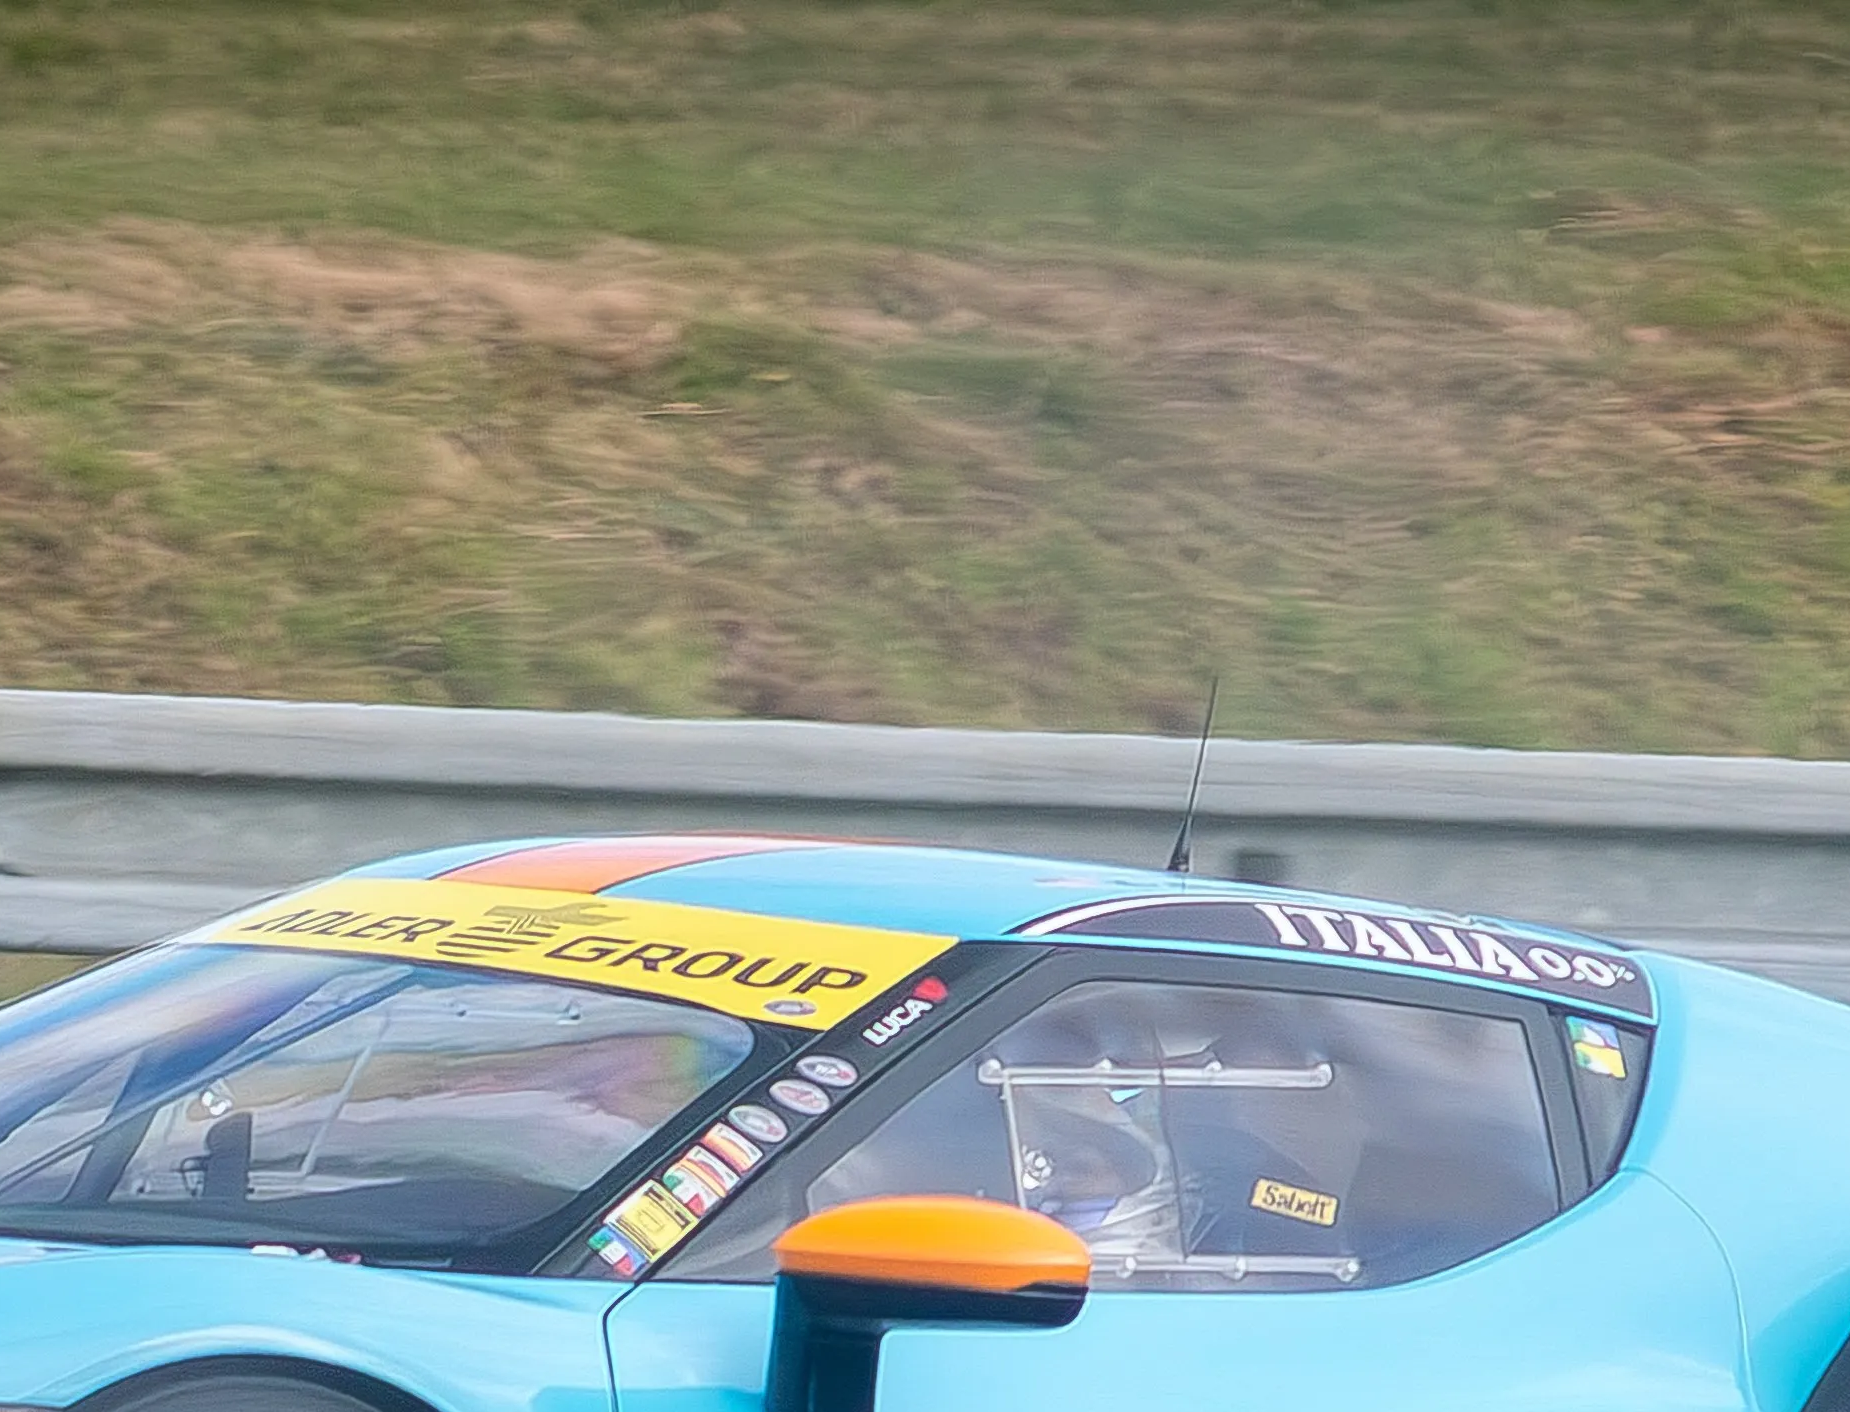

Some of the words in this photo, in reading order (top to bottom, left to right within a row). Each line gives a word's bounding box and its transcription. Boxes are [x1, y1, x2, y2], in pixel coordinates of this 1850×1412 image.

[240, 908, 455, 943] ADLER
[544, 935, 868, 994] GROUP
[1255, 902, 1540, 982] ITALIA
[862, 998, 934, 1046] LUCA
